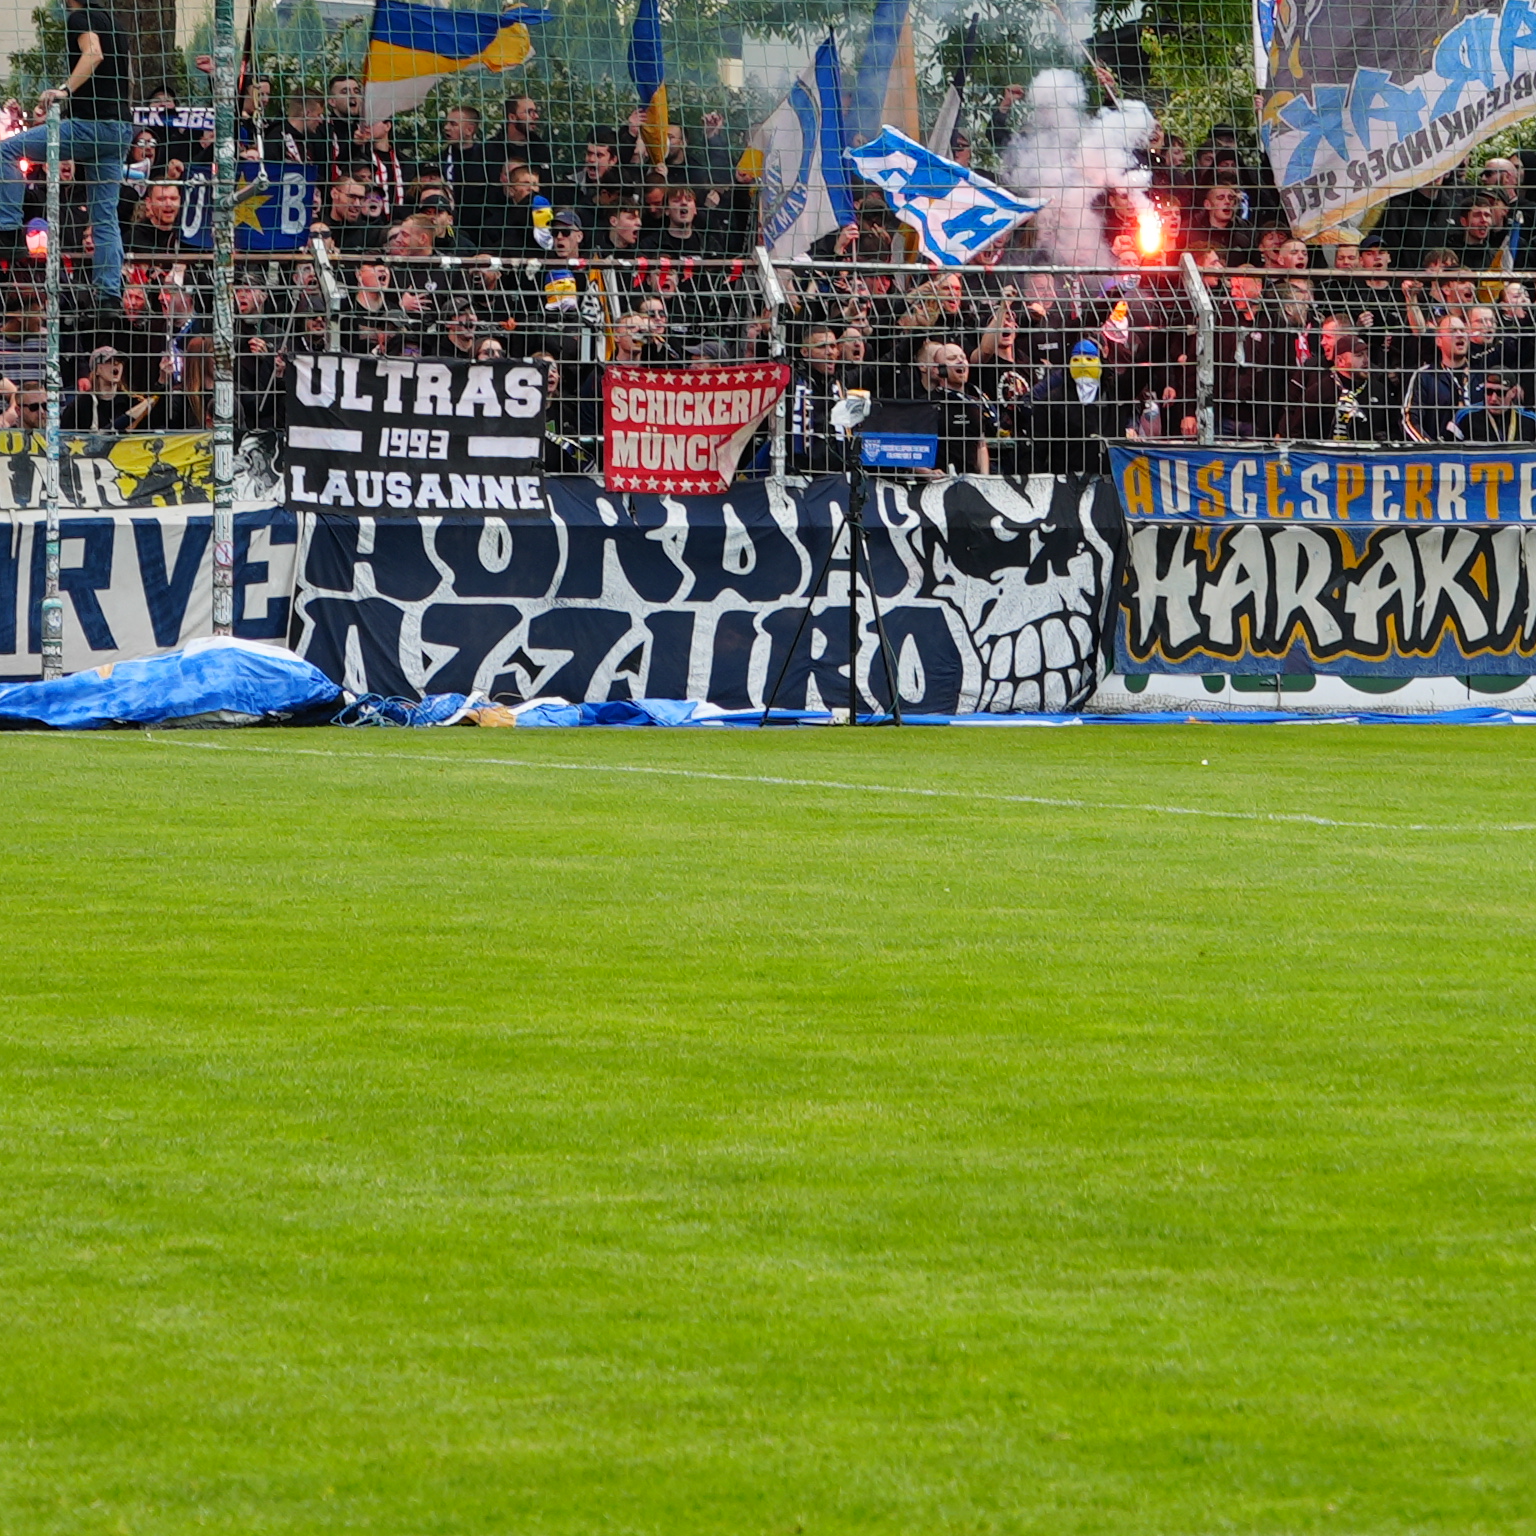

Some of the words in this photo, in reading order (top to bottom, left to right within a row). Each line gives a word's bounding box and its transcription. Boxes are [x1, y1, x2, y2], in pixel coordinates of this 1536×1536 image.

[180, 172, 208, 239] U
[280, 171, 307, 235] B
[293, 354, 543, 418] ULTRAS
[610, 385, 778, 426] SCHICKERIA
[378, 426, 450, 460] 1993
[290, 465, 545, 509] LAUSANNE
